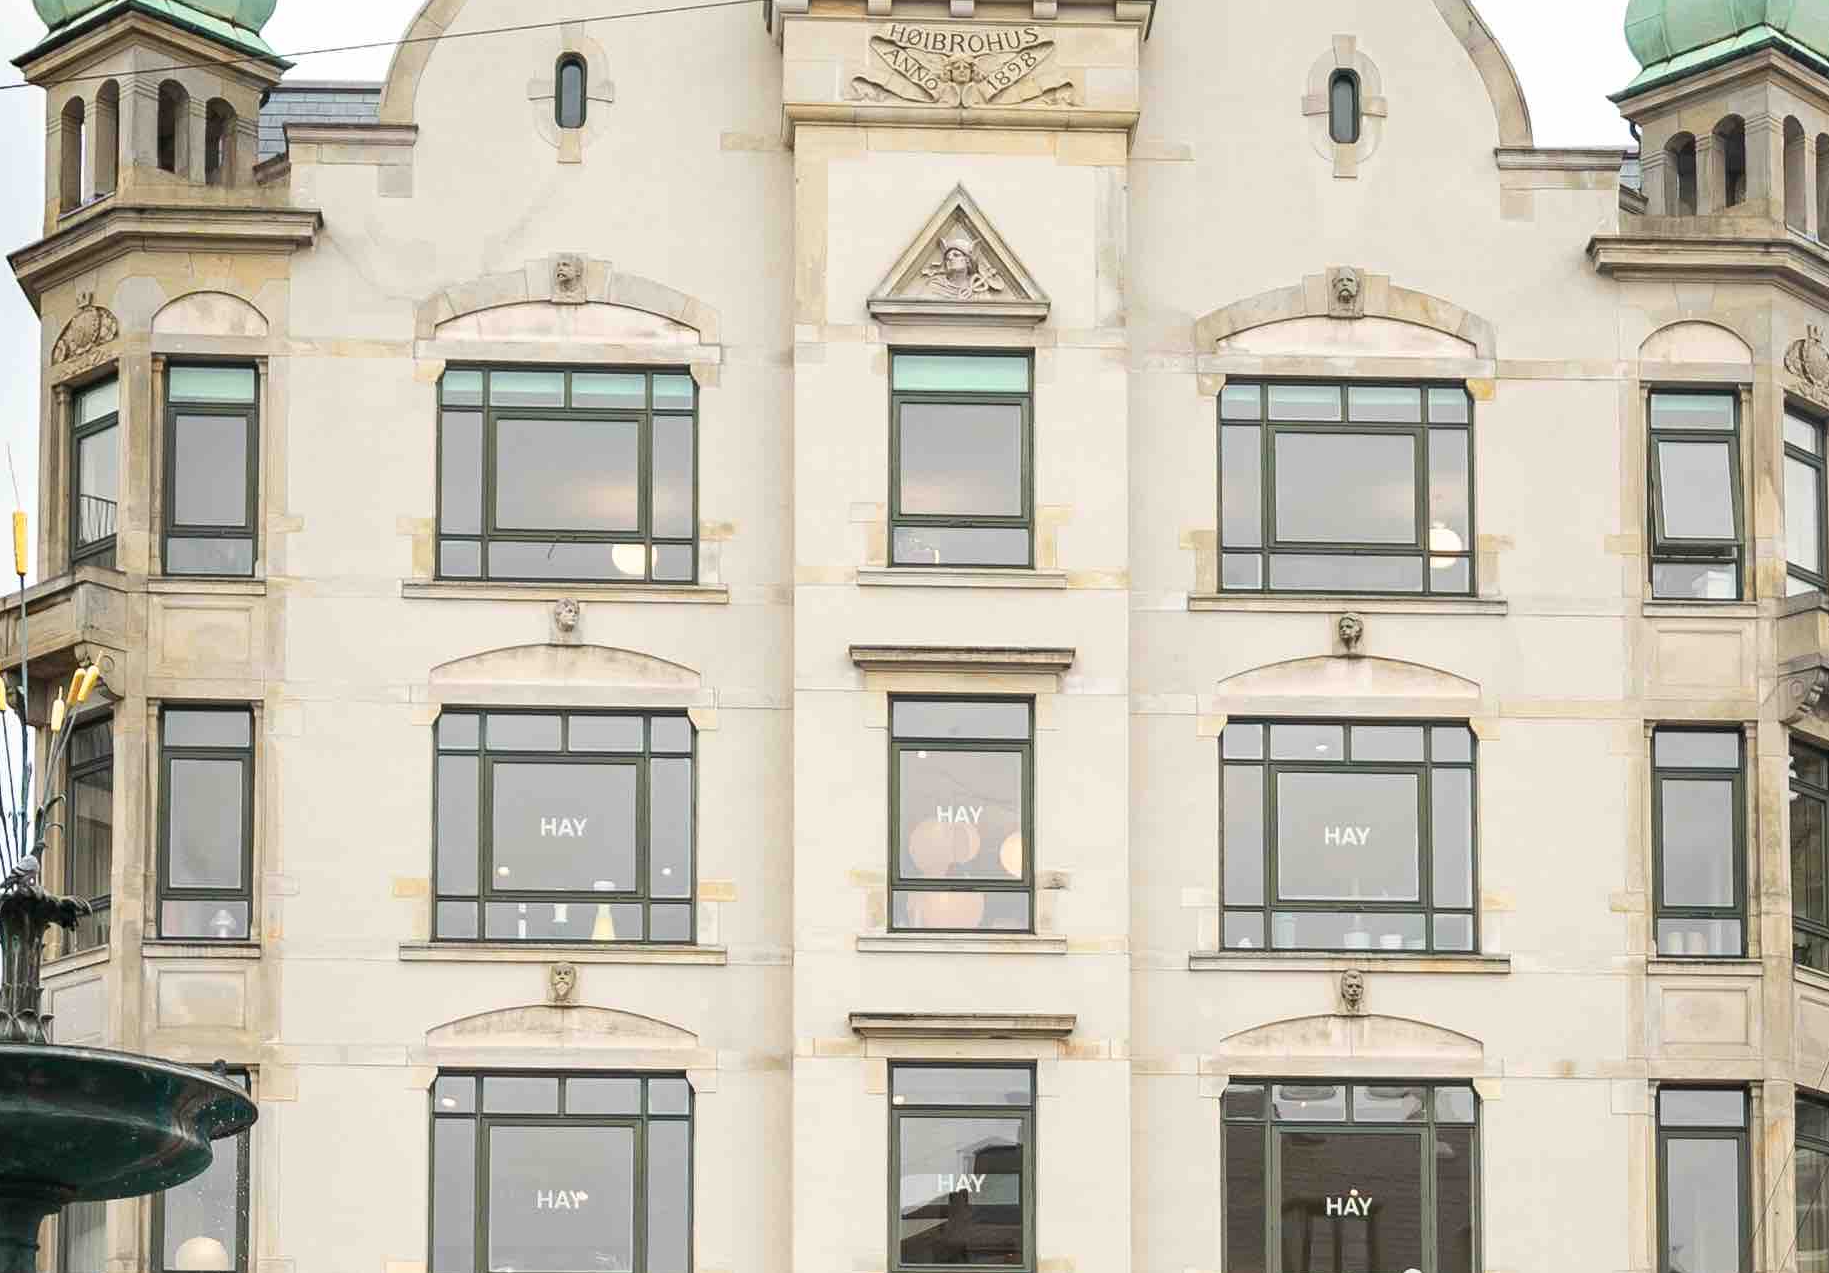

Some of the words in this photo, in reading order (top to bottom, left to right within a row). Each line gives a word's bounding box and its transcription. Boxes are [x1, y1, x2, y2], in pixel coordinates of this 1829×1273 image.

[883, 47, 939, 91] ANNO
[987, 51, 1037, 91] 1898
[936, 805, 984, 824] HAY
[540, 817, 588, 836] HAY
[1323, 826, 1371, 846] HAY
[936, 1173, 986, 1193] HAY
[536, 1189, 584, 1210] HAY
[1325, 1196, 1373, 1217] HAY
